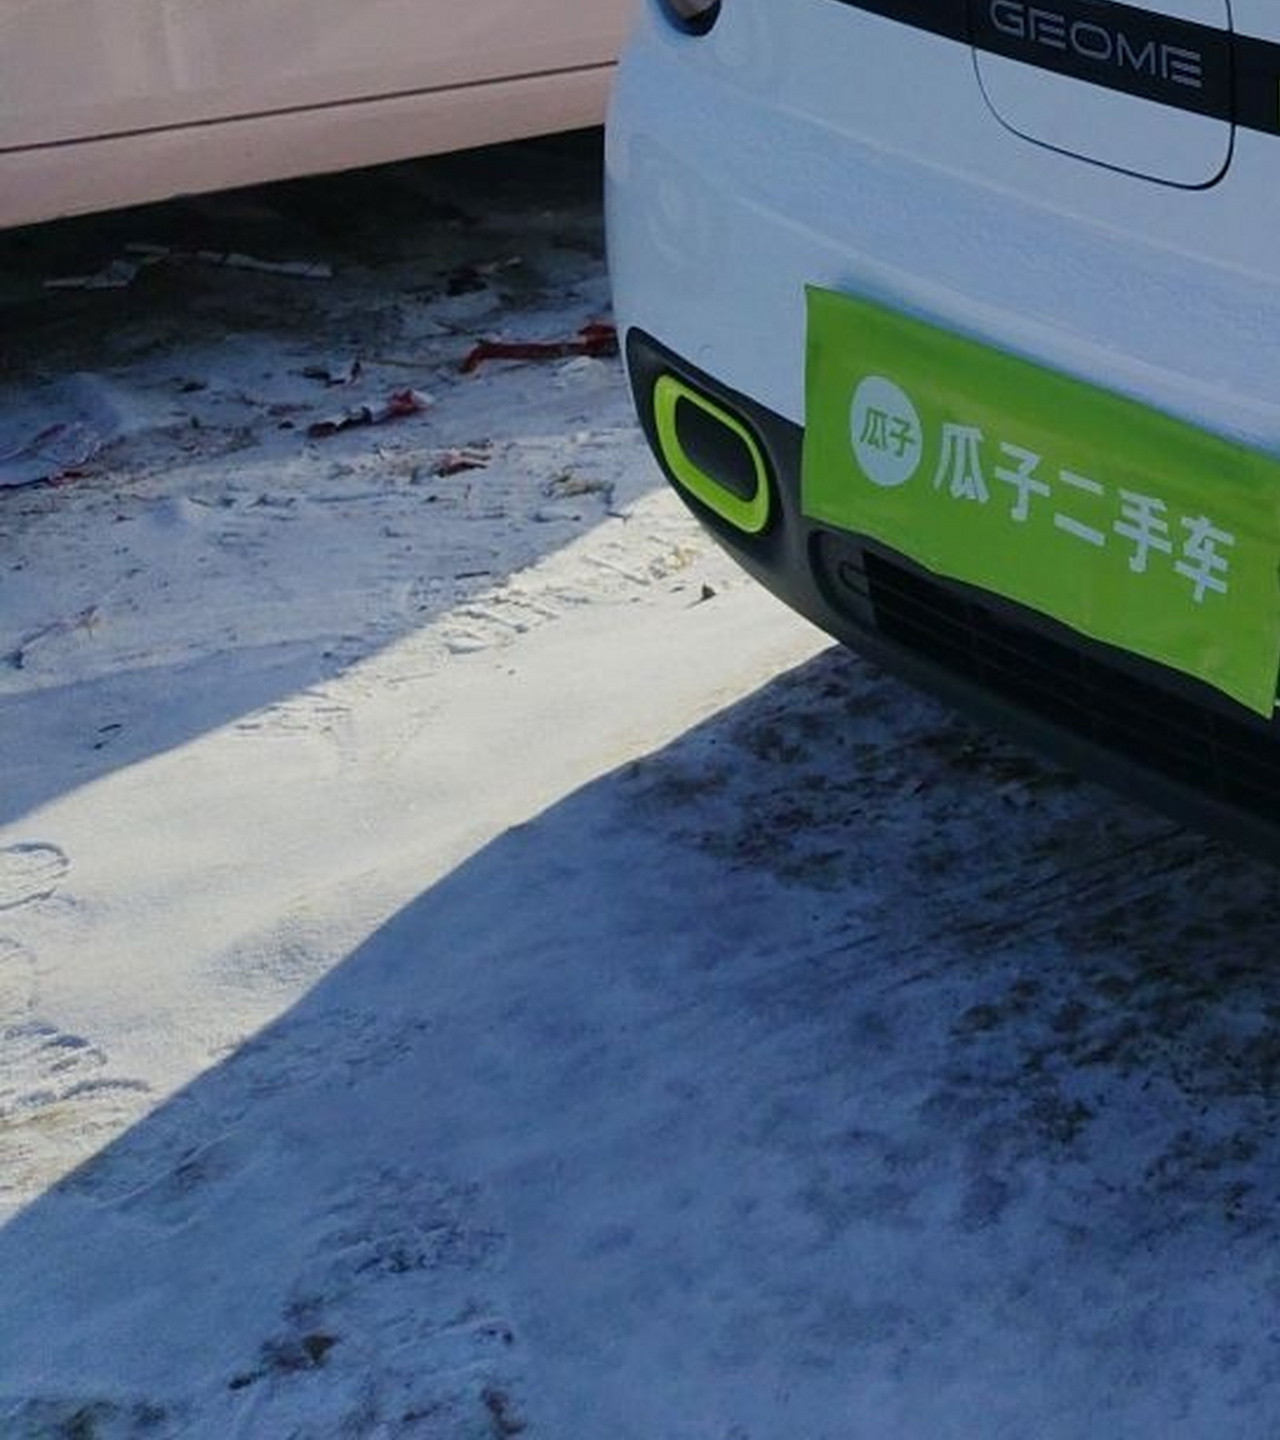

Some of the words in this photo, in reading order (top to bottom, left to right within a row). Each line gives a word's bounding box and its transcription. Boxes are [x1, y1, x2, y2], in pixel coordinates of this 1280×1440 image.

[856, 406, 918, 454] 瓜子
[932, 421, 1237, 603] 瓜子二手车
